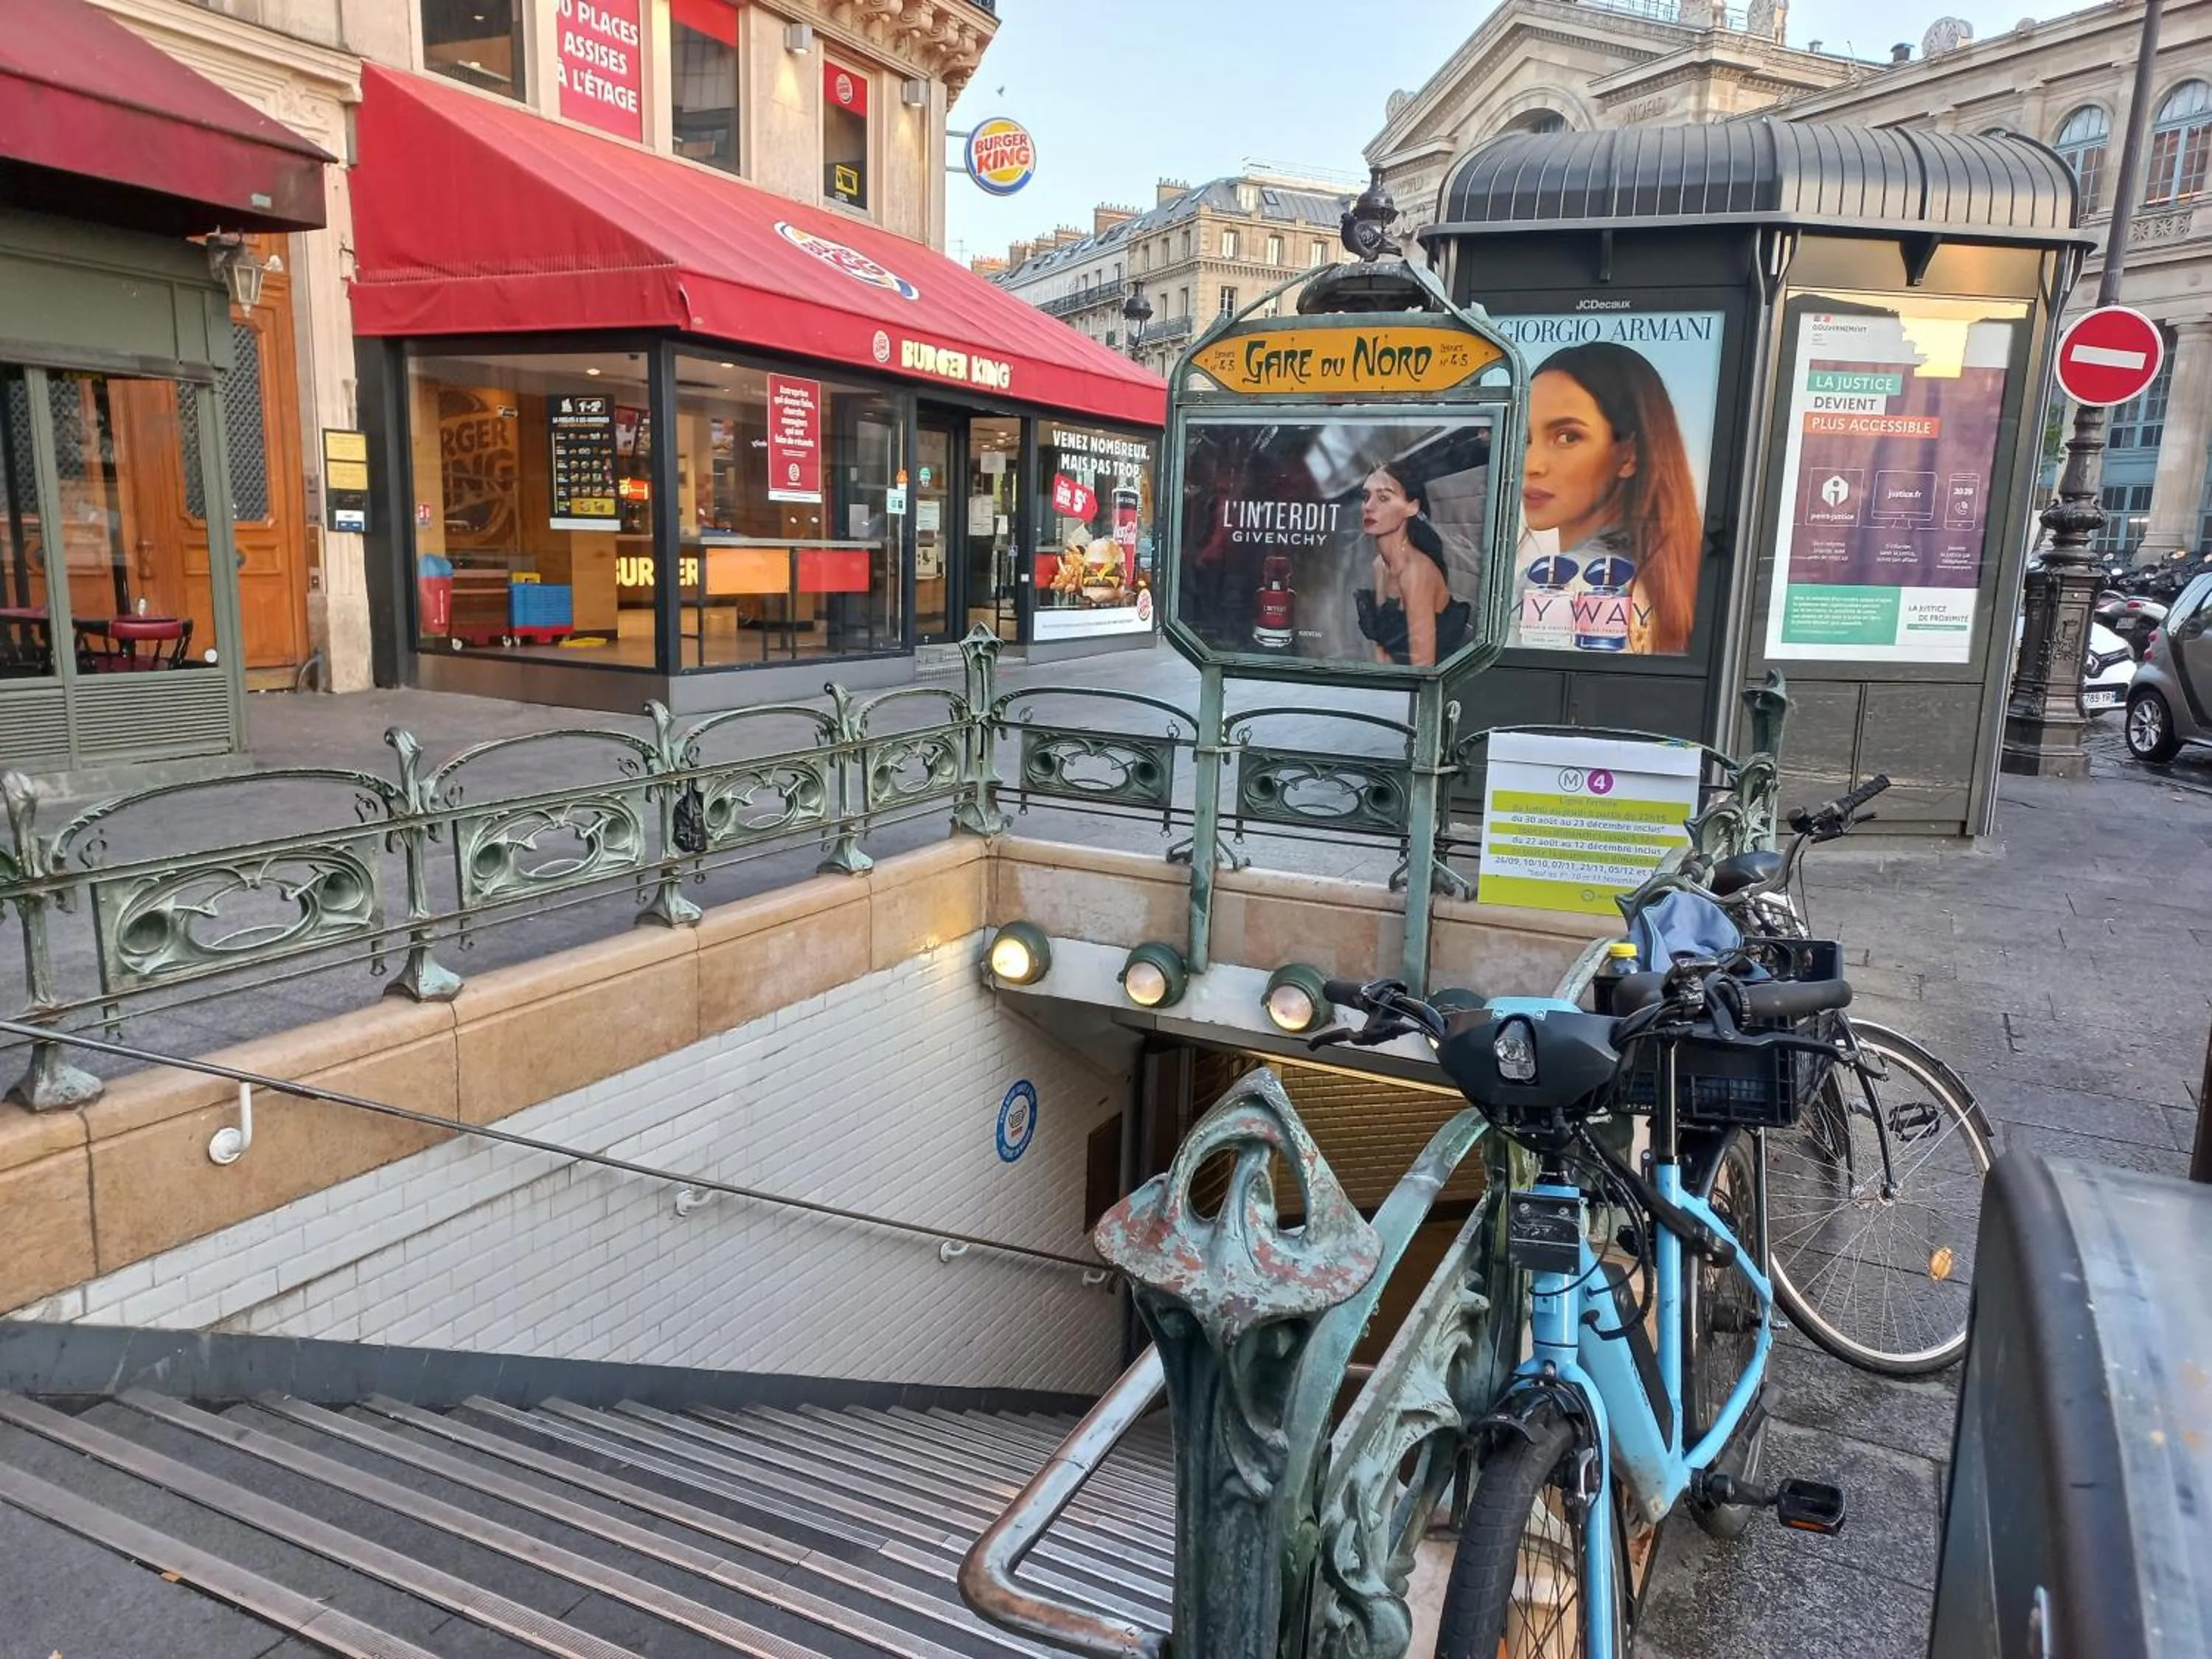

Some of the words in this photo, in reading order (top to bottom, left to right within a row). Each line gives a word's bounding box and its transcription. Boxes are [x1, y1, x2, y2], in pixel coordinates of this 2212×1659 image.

[577, 1, 638, 46] PLACES
[564, 31, 627, 75] ASSISES
[573, 69, 638, 114] L'ÉTAGE
[975, 133, 1027, 154] BURGER
[977, 147, 1030, 174] KING
[1576, 299, 1630, 310] JCDecaux
[1498, 318, 1601, 343] GIORGIO
[1610, 316, 1714, 341] ARMANI
[901, 339, 968, 380] BURGER
[971, 355, 1010, 389] KING
[1353, 336, 1433, 383] NORD
[1816, 375, 1833, 388] LA
[1836, 377, 1893, 392] JUSTICE
[1814, 396, 1877, 411] DEVIENT
[1812, 417, 1846, 431] PLUS
[1849, 420, 1932, 435] ACCESSIBLE
[441, 419, 509, 458] RGER
[1053, 429, 1088, 451] VENEZ
[1062, 453, 1088, 471] MAIS
[1091, 458, 1111, 476] PAS
[1888, 489, 1922, 499] justice.fr
[1223, 500, 1341, 532] L'INTERDIT
[1232, 531, 1327, 546] GIVENCHY
[616, 557, 698, 587] URER
[1570, 600, 1652, 626] WAY
[1919, 605, 1947, 613] JUSTICE
[1593, 773, 1607, 790] 4
[1525, 815, 1536, 824] 30
[1538, 817, 1558, 825] août
[1587, 820, 1632, 831] décembre
[1538, 838, 1558, 846] août
[1587, 842, 1632, 853] décembre
[1635, 846, 1661, 855] inclus
